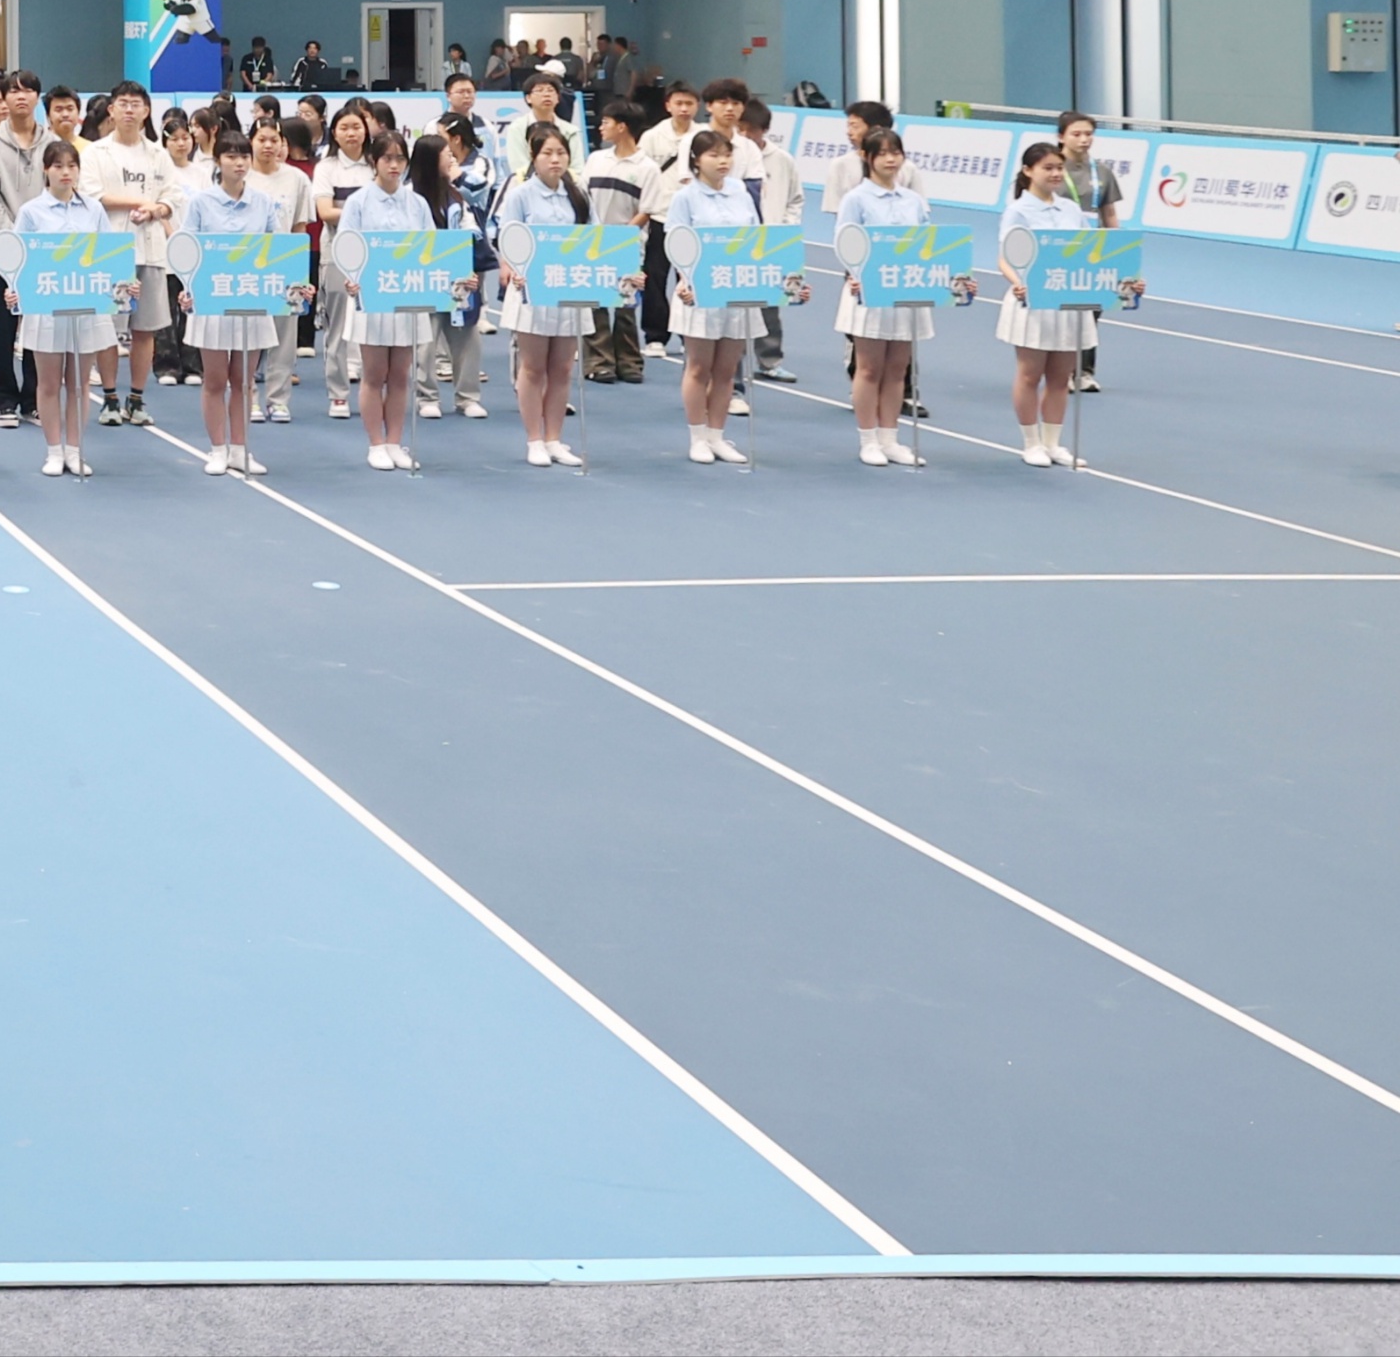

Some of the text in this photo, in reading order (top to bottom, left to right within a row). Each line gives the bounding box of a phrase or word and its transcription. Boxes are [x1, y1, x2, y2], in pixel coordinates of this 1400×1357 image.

[1192, 177, 1290, 201] 四川蜀华川体
[1366, 194, 1400, 213] 四川
[36, 271, 111, 295] 乐山市
[211, 273, 285, 296] 宜宾市
[378, 269, 450, 293] 达州市
[544, 264, 616, 288] 雅安市
[711, 264, 783, 289] 资阳市
[879, 263, 951, 288] 甘孜州
[1043, 267, 1119, 292] 凉山州
